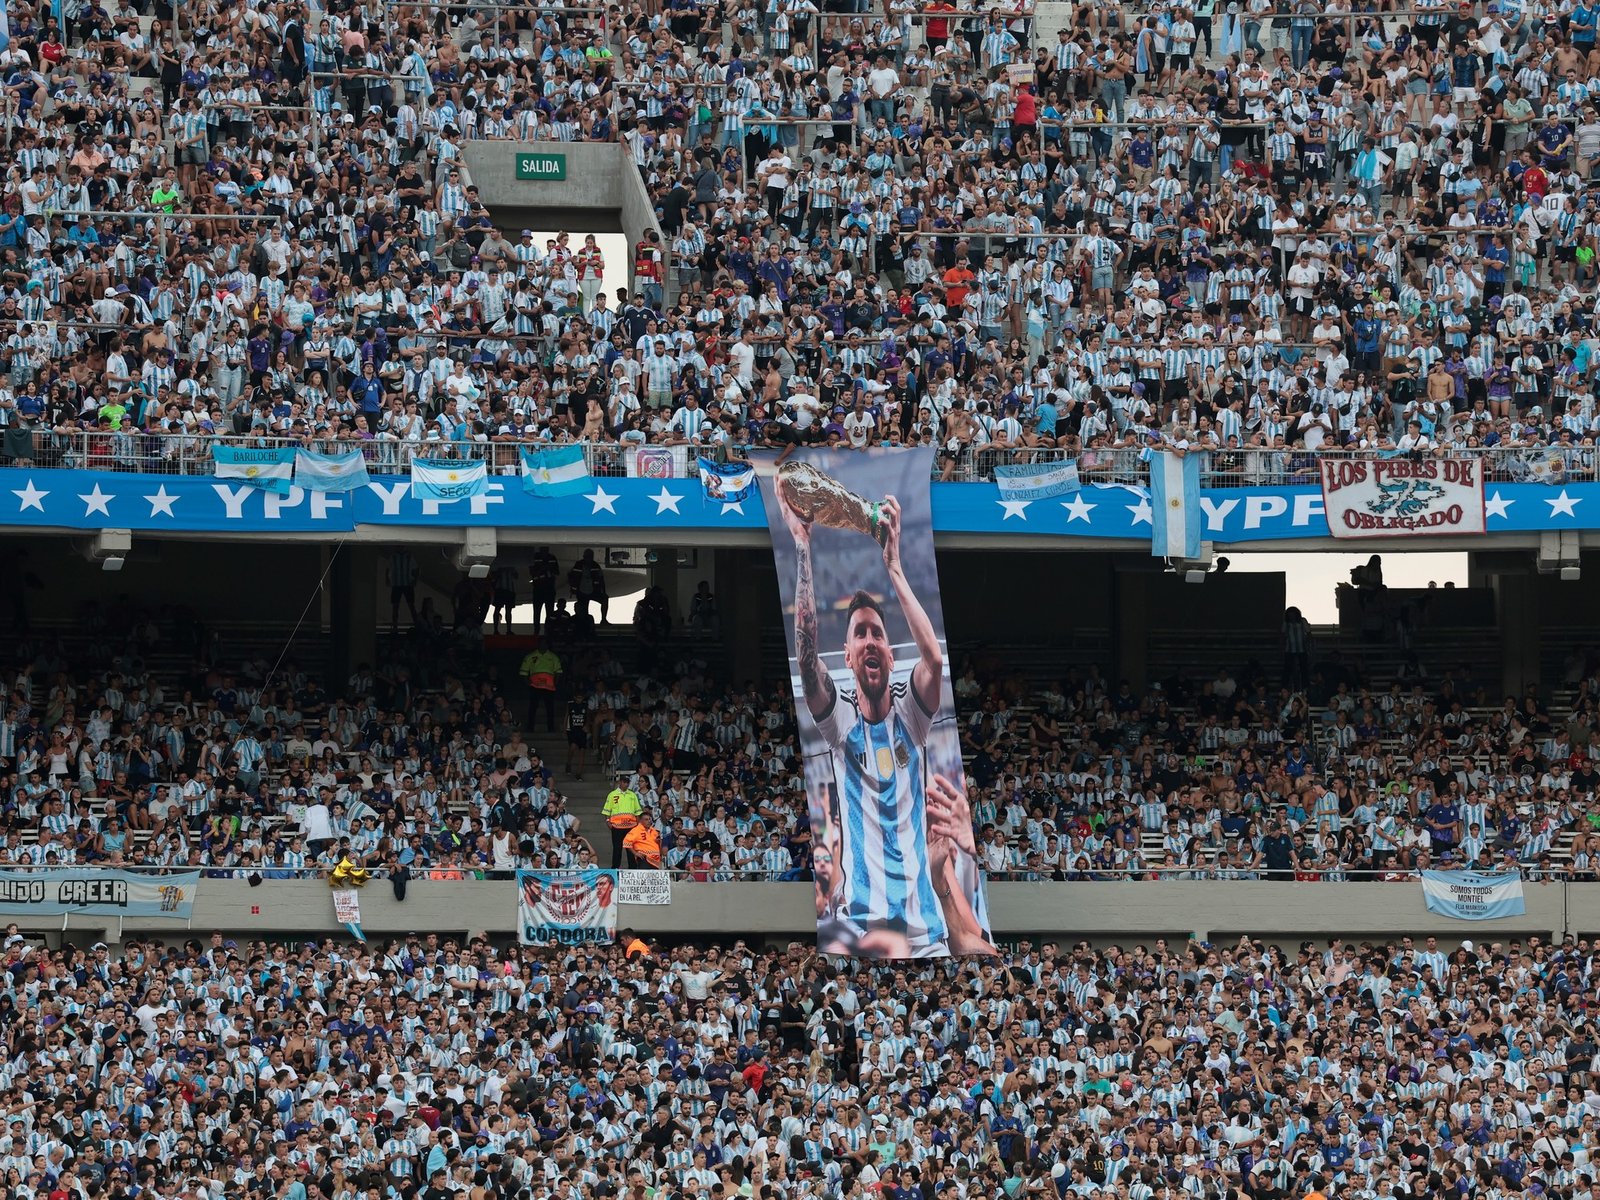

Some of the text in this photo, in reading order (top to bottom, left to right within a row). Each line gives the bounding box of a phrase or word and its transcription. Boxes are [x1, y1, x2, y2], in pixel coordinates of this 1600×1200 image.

[522, 159, 560, 173] SALIDA
[1544, 197, 1559, 211] 10
[233, 451, 279, 462] BARILOCHE
[1325, 460, 1474, 493] LOS PIBES DE
[440, 487, 471, 497] SECO
[1199, 494, 1326, 531] YPF
[1343, 504, 1464, 531] OBLIGADO
[58, 879, 127, 907] CREER
[1450, 884, 1493, 895] SOMOS TODOS
[1458, 894, 1485, 903] MONTIEL
[525, 923, 609, 943] CÓRDOBA
[1093, 1160, 1104, 1170] 10
